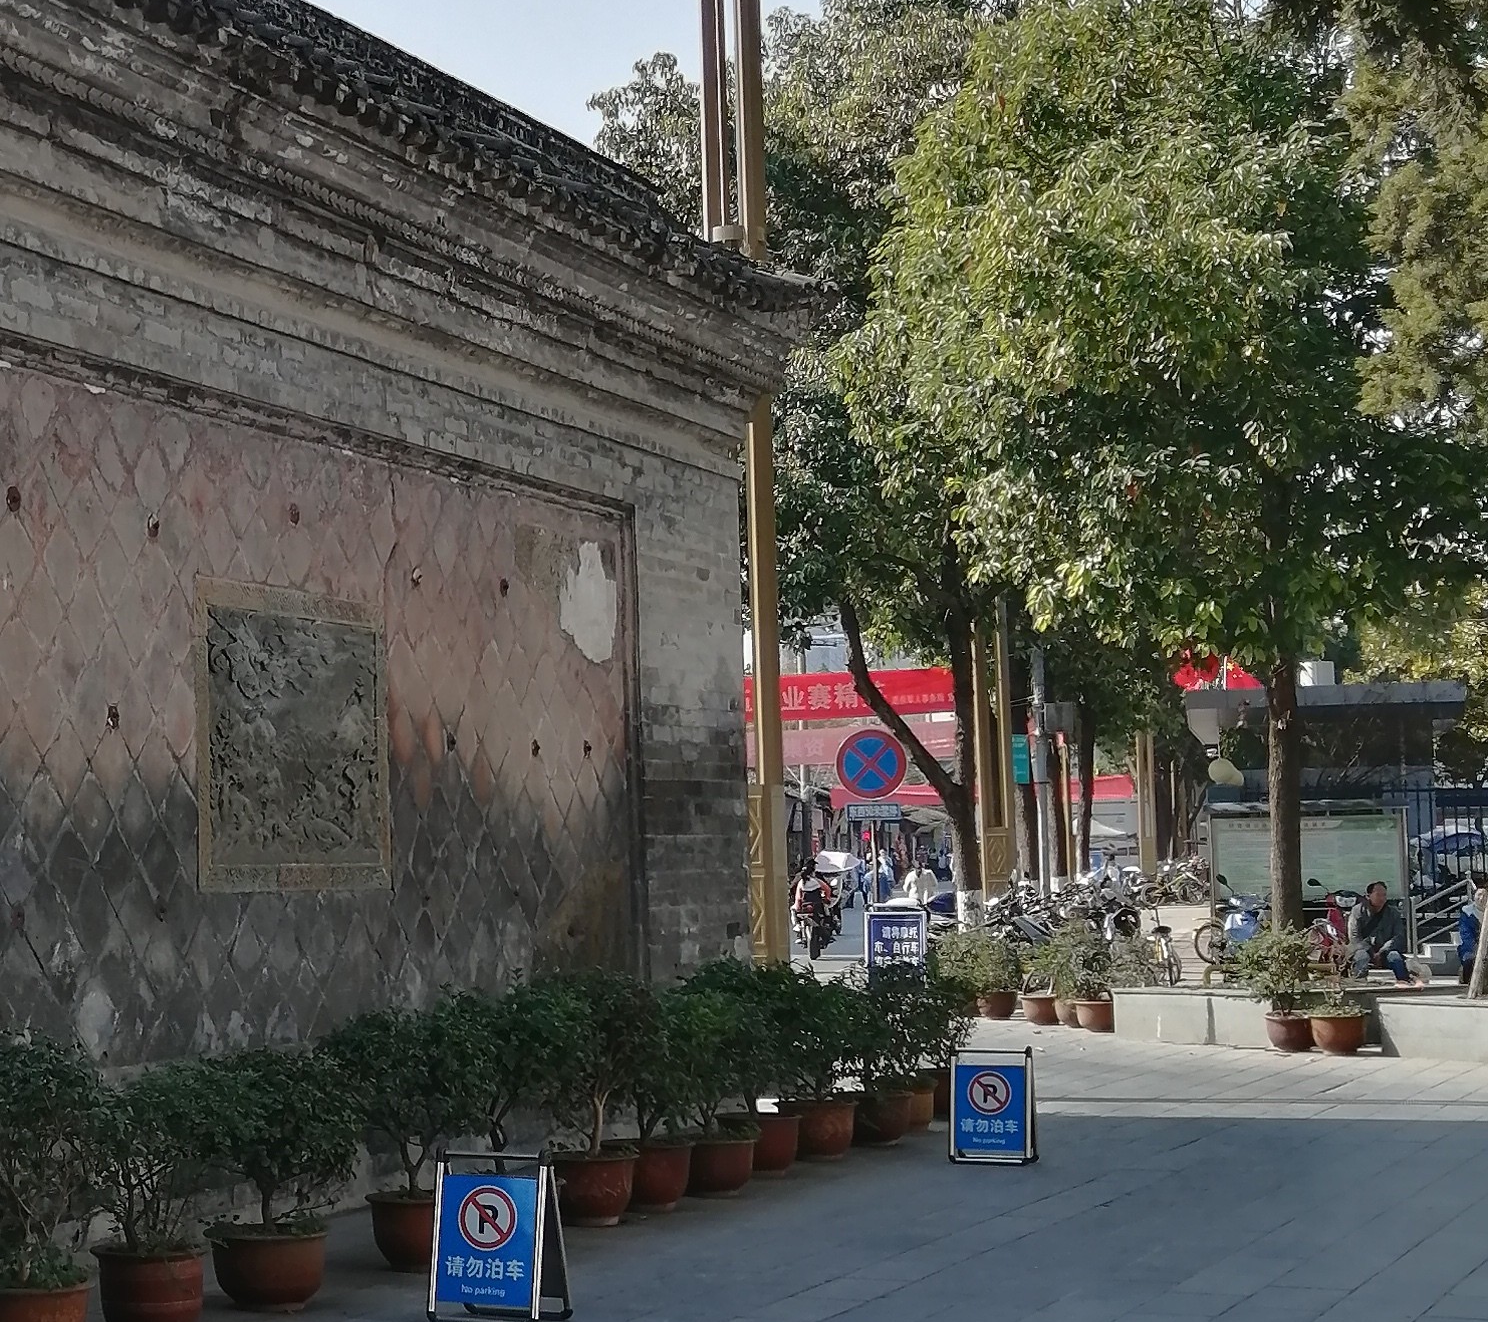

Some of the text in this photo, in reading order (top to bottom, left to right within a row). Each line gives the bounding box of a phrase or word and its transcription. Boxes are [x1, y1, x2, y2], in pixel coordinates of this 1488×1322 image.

[960, 1117, 1019, 1134] 请勿泊车
[445, 1255, 525, 1282] 请勿泊车
[461, 1283, 506, 1298] No parking
